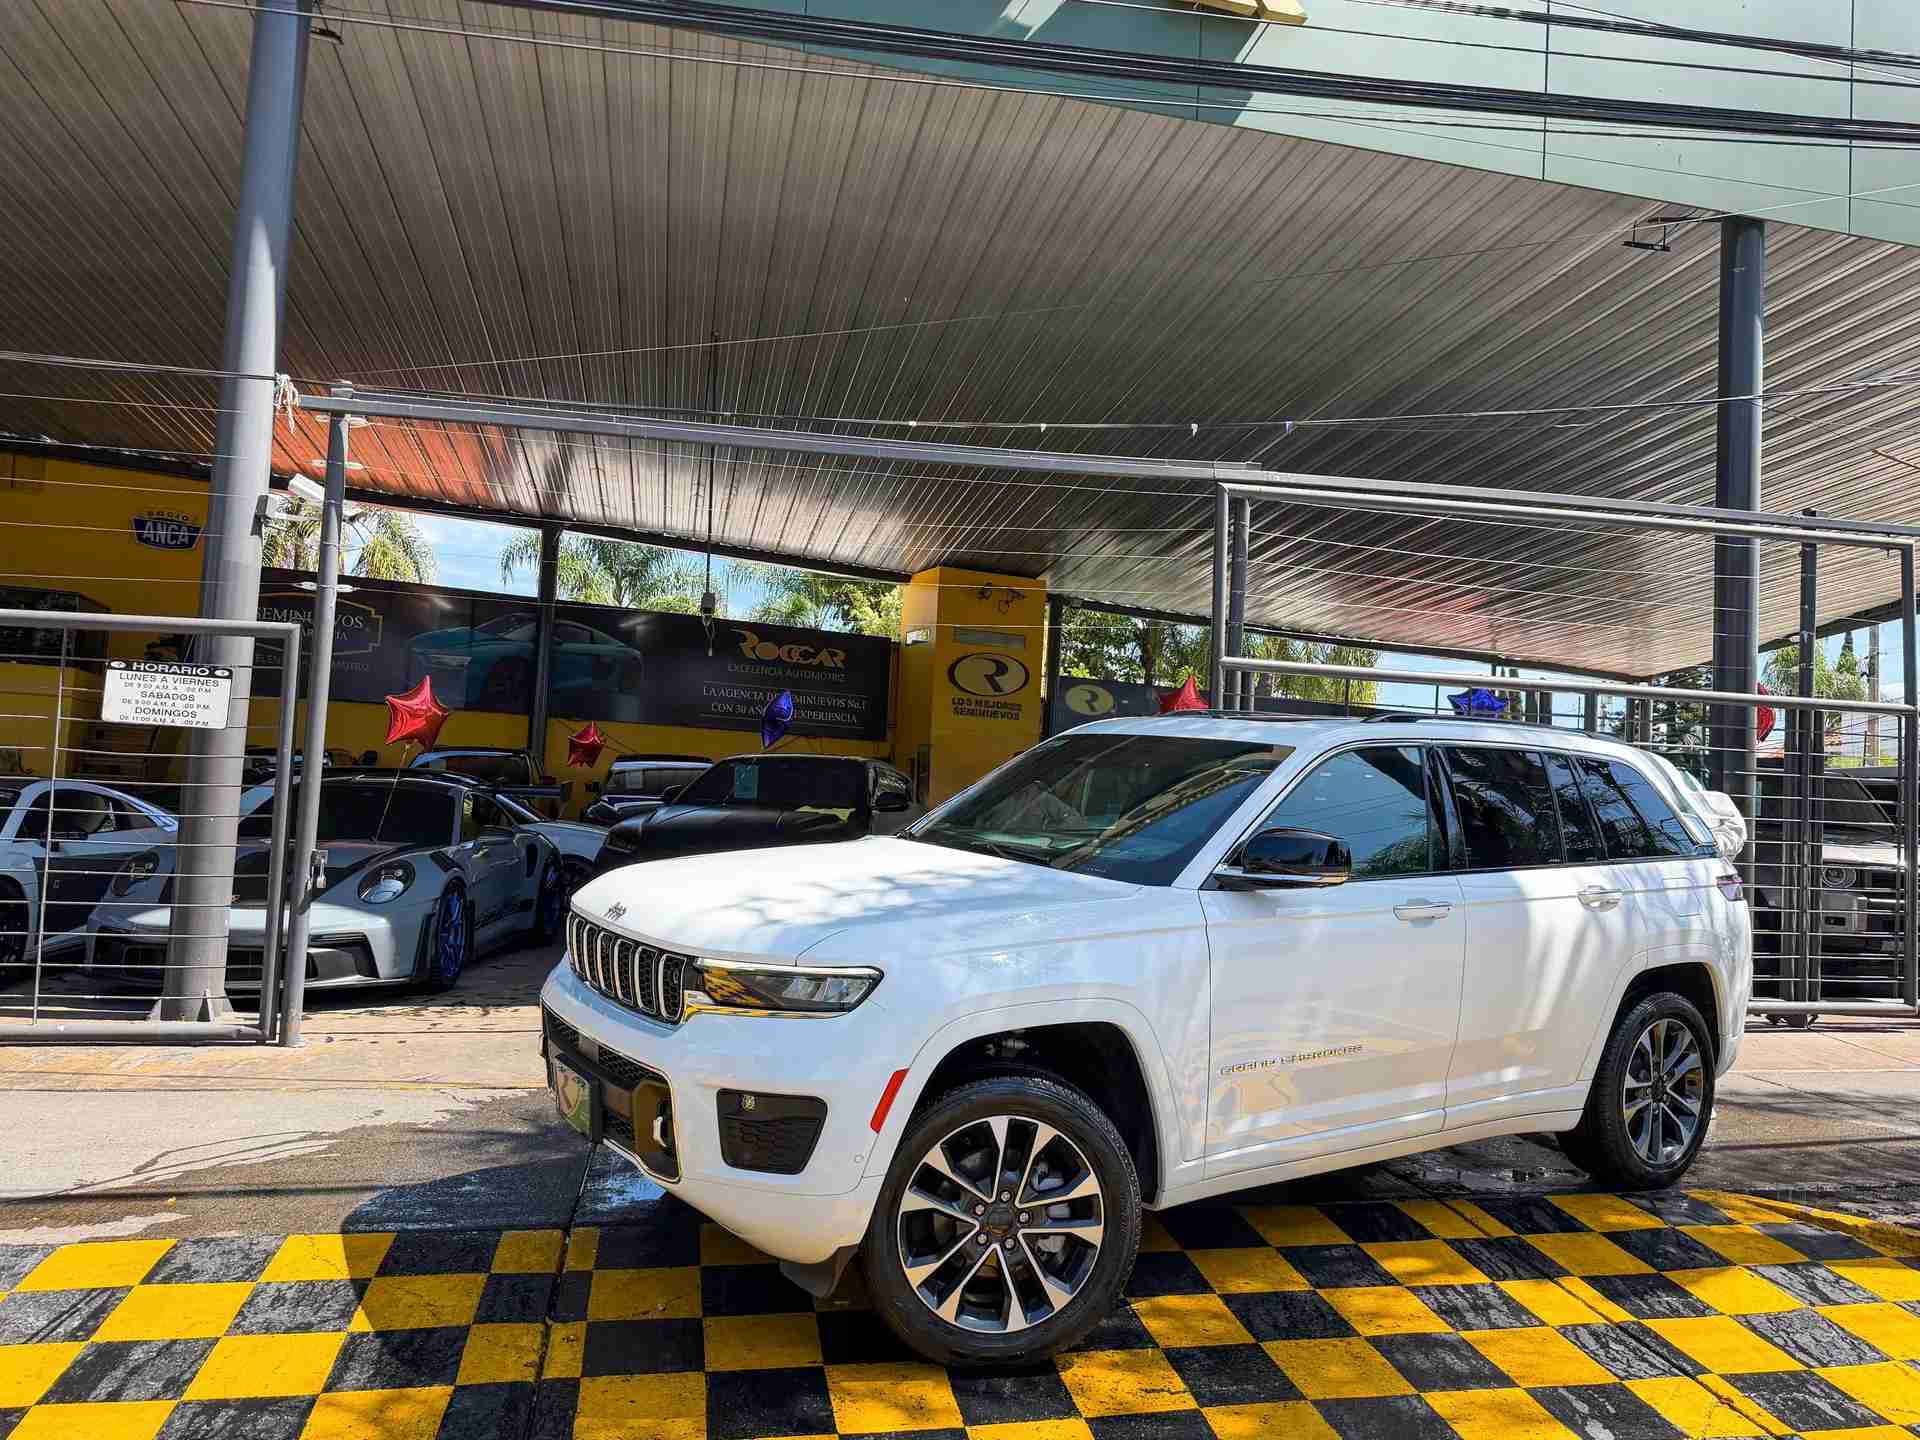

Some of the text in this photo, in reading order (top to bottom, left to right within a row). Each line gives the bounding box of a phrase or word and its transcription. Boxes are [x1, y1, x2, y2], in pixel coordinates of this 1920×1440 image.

[143, 520, 189, 545] ANCA
[132, 661, 210, 676] HORARIO
[119, 672, 220, 688] LUNES A VIERNES
[121, 697, 132, 705] DE
[703, 686, 714, 697] LA
[715, 687, 765, 701] AGENCIA
[794, 693, 846, 709] MINUEVOS
[952, 697, 1022, 712] LOS MEJORES
[135, 706, 198, 719] DOMINGOS
[711, 701, 734, 714] CON
[793, 708, 858, 724] EXPERIENCIA
[952, 705, 1021, 721] SEMINUEVOS
